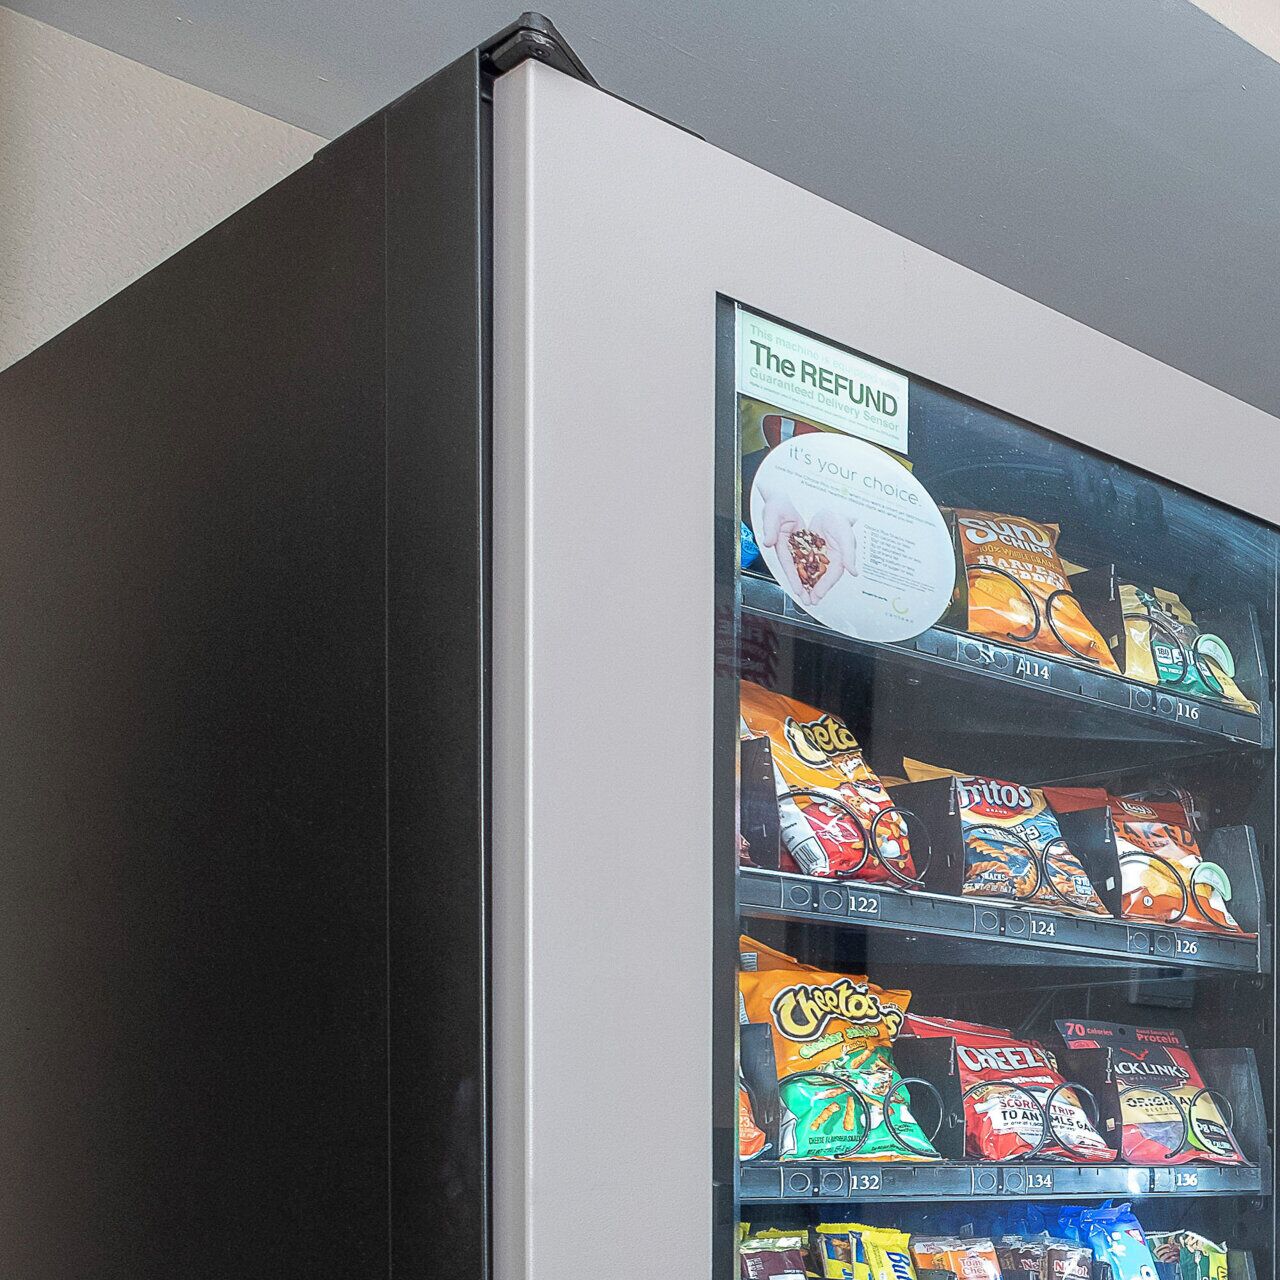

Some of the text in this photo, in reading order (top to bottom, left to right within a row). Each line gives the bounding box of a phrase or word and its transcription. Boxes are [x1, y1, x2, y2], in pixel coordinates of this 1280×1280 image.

[750, 324, 773, 342] This
[750, 340, 796, 378] The
[801, 360, 898, 417] REFUND
[750, 368, 814, 399] Guaranteed
[818, 393, 860, 418] Delivery
[863, 411, 899, 431] Sensor
[790, 445, 812, 464] it's
[818, 458, 858, 481] your
[999, 534, 1053, 558] CHIPS
[1178, 702, 1198, 719] 116
[956, 778, 1032, 808] Fritos
[850, 897, 877, 913] 122
[1031, 921, 1055, 935] 124
[1177, 940, 1197, 953] 126
[778, 982, 880, 1036] Cheetos
[1065, 1023, 1113, 1036] 70 calories
[1137, 1034, 1179, 1044] Protein
[1002, 1110, 1017, 1120] TO
[1051, 1105, 1075, 1116] TRIP
[852, 1175, 880, 1190] 132
[1029, 1174, 1052, 1187] 134
[1177, 1174, 1197, 1186] 136
[1054, 1260, 1088, 1276] Not
